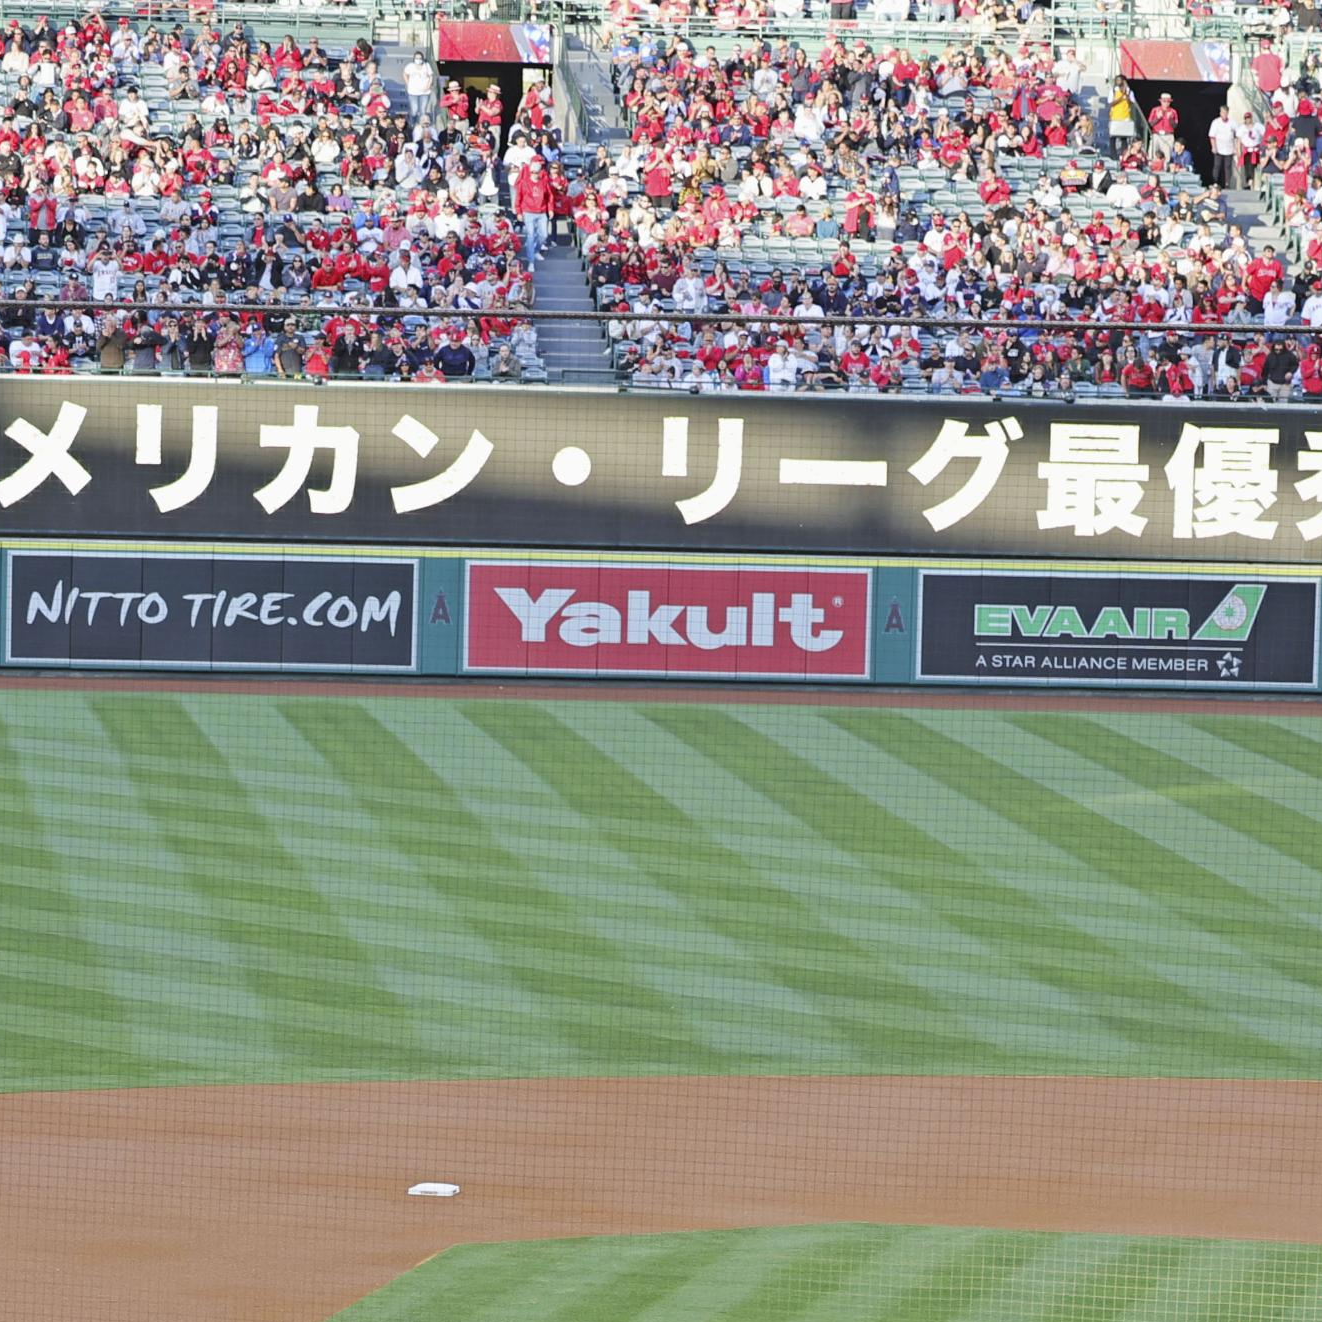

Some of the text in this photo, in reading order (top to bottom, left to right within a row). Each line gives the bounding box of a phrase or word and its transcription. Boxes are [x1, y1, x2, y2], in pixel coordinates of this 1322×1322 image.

[27, 580, 402, 637] NITTO TIRE.COM
[493, 587, 844, 652] Yakult
[976, 655, 1209, 672] A STAR ALLIANCE MEMBER
